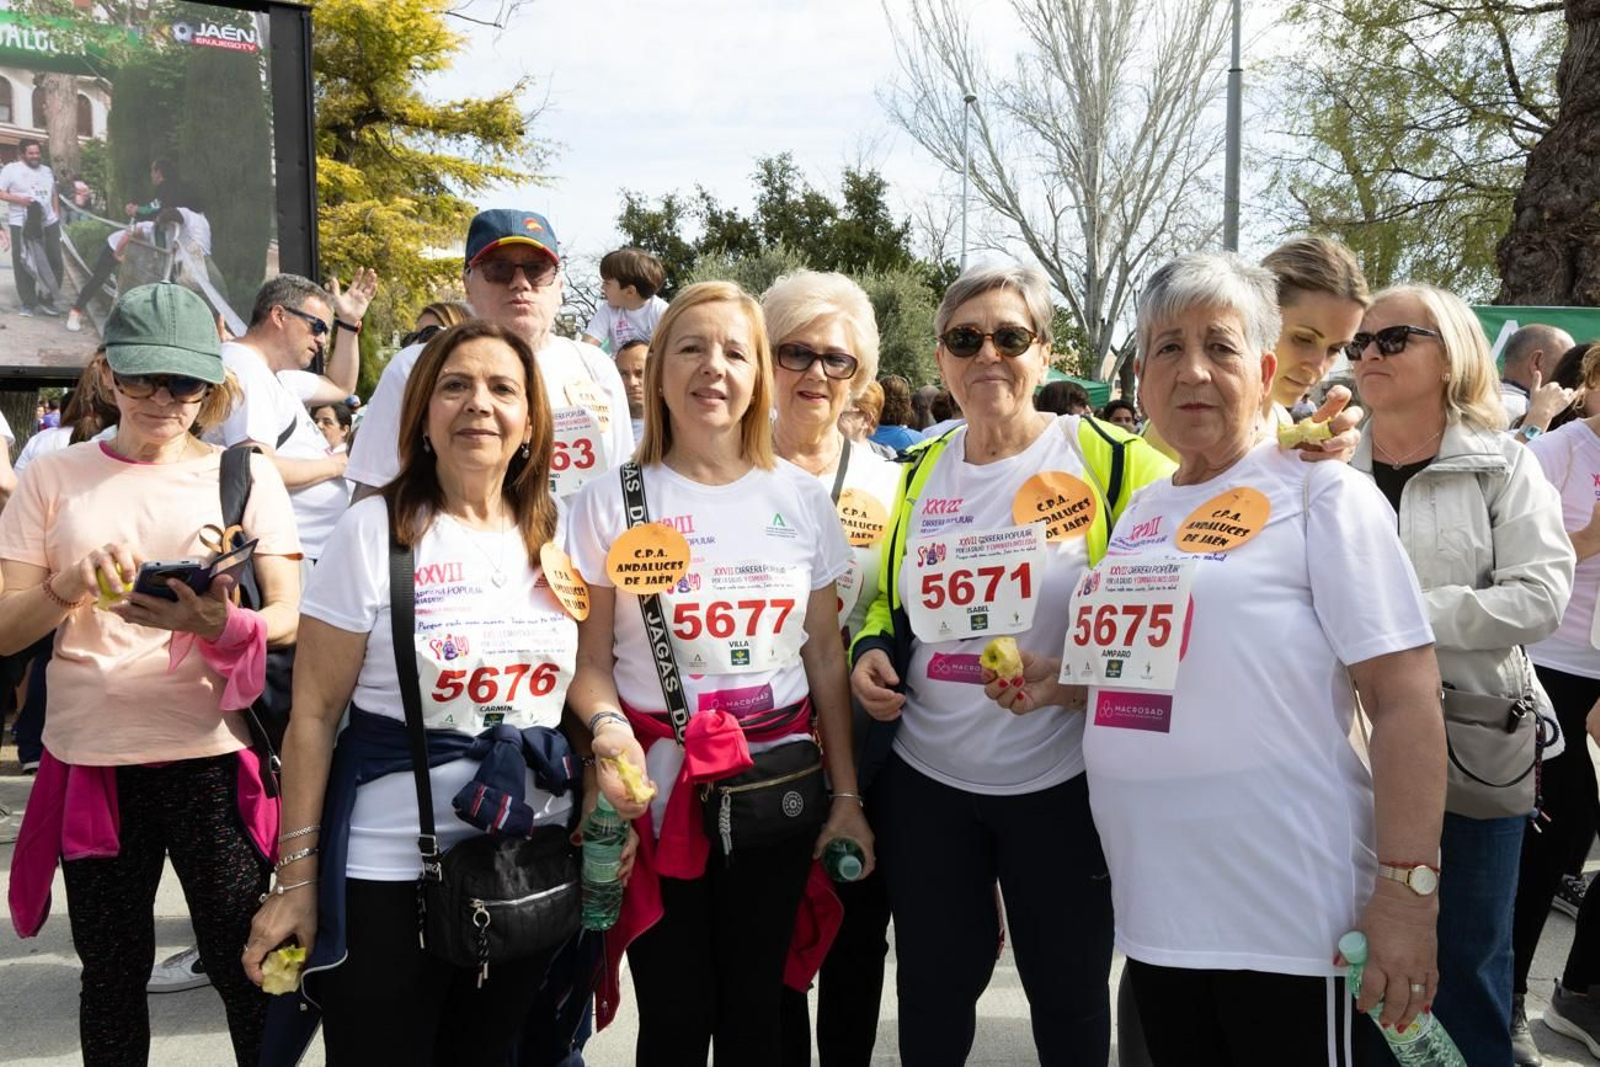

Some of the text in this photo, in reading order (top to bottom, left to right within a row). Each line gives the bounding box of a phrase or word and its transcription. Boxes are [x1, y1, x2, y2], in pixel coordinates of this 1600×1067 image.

[196, 23, 255, 43] JAÉN
[550, 438, 595, 471] 63
[1037, 494, 1070, 512] C.P.A.
[1211, 509, 1241, 522] C.P.A.
[1004, 528, 1033, 539] POPULAR
[1045, 527, 1059, 539] DE
[1186, 521, 1251, 537] ANDALUCES
[1182, 533, 1199, 542] DE
[634, 548, 668, 558] C.P.A.
[616, 561, 684, 572] ANDALUCES
[624, 576, 640, 585] DE
[922, 562, 1032, 610] 5671
[966, 605, 990, 614] ISABEL
[673, 599, 795, 641] 5677
[1073, 604, 1173, 648] 5675
[728, 640, 749, 648] VILLA
[647, 612, 679, 693] JAGAS
[1101, 649, 1132, 658] AMPARO
[432, 662, 561, 703] 5676
[1114, 705, 1164, 716] MACROSAD
